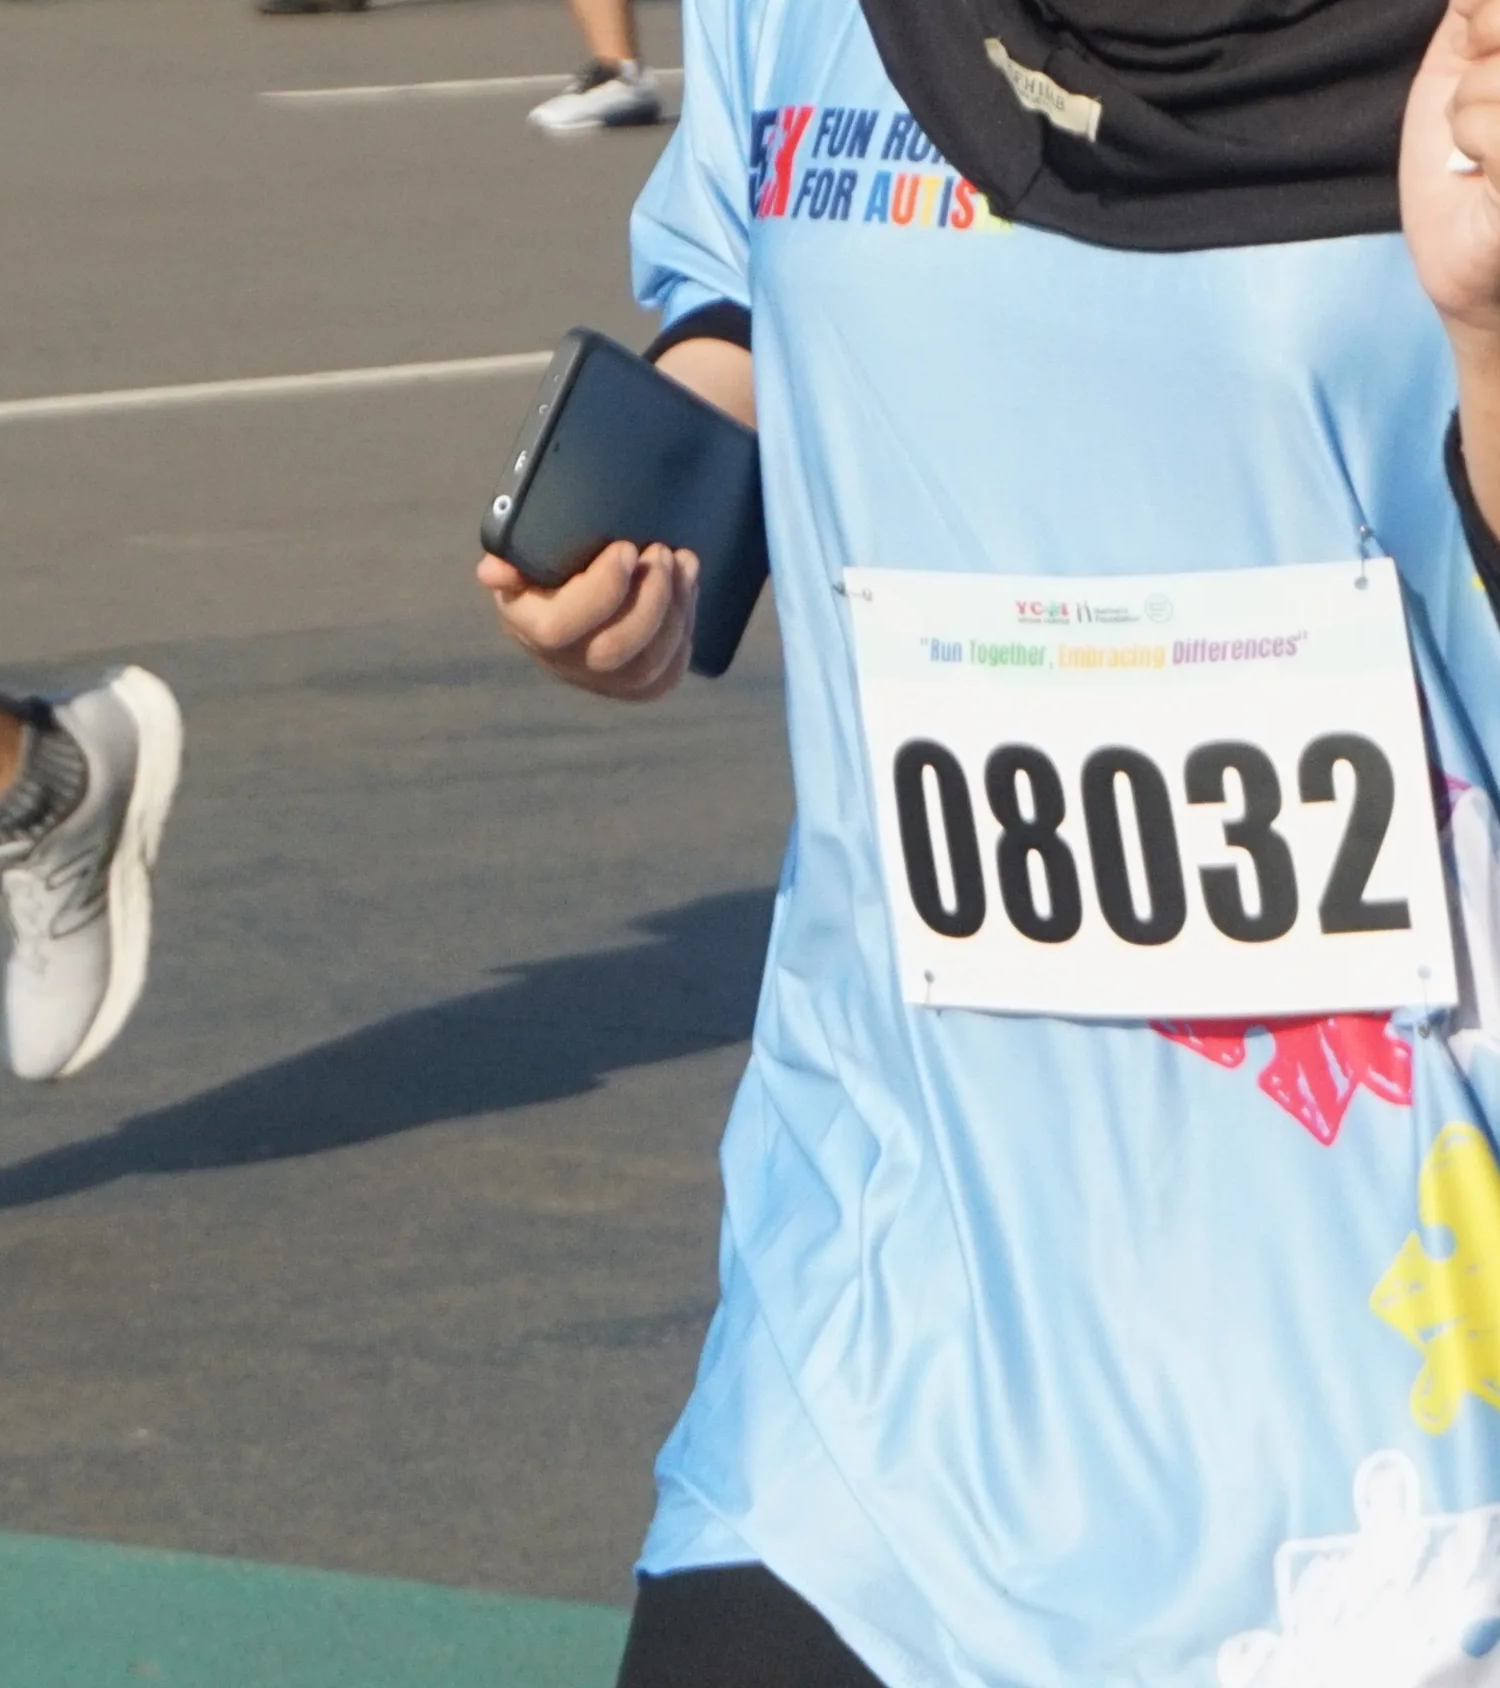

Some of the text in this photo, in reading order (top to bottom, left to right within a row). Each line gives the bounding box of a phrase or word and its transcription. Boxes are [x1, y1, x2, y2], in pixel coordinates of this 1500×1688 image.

[812, 108, 941, 164] FUN RU
[791, 168, 857, 221] FOR
[1057, 643, 1166, 670] Embracing
[892, 730, 1412, 947] 08032
